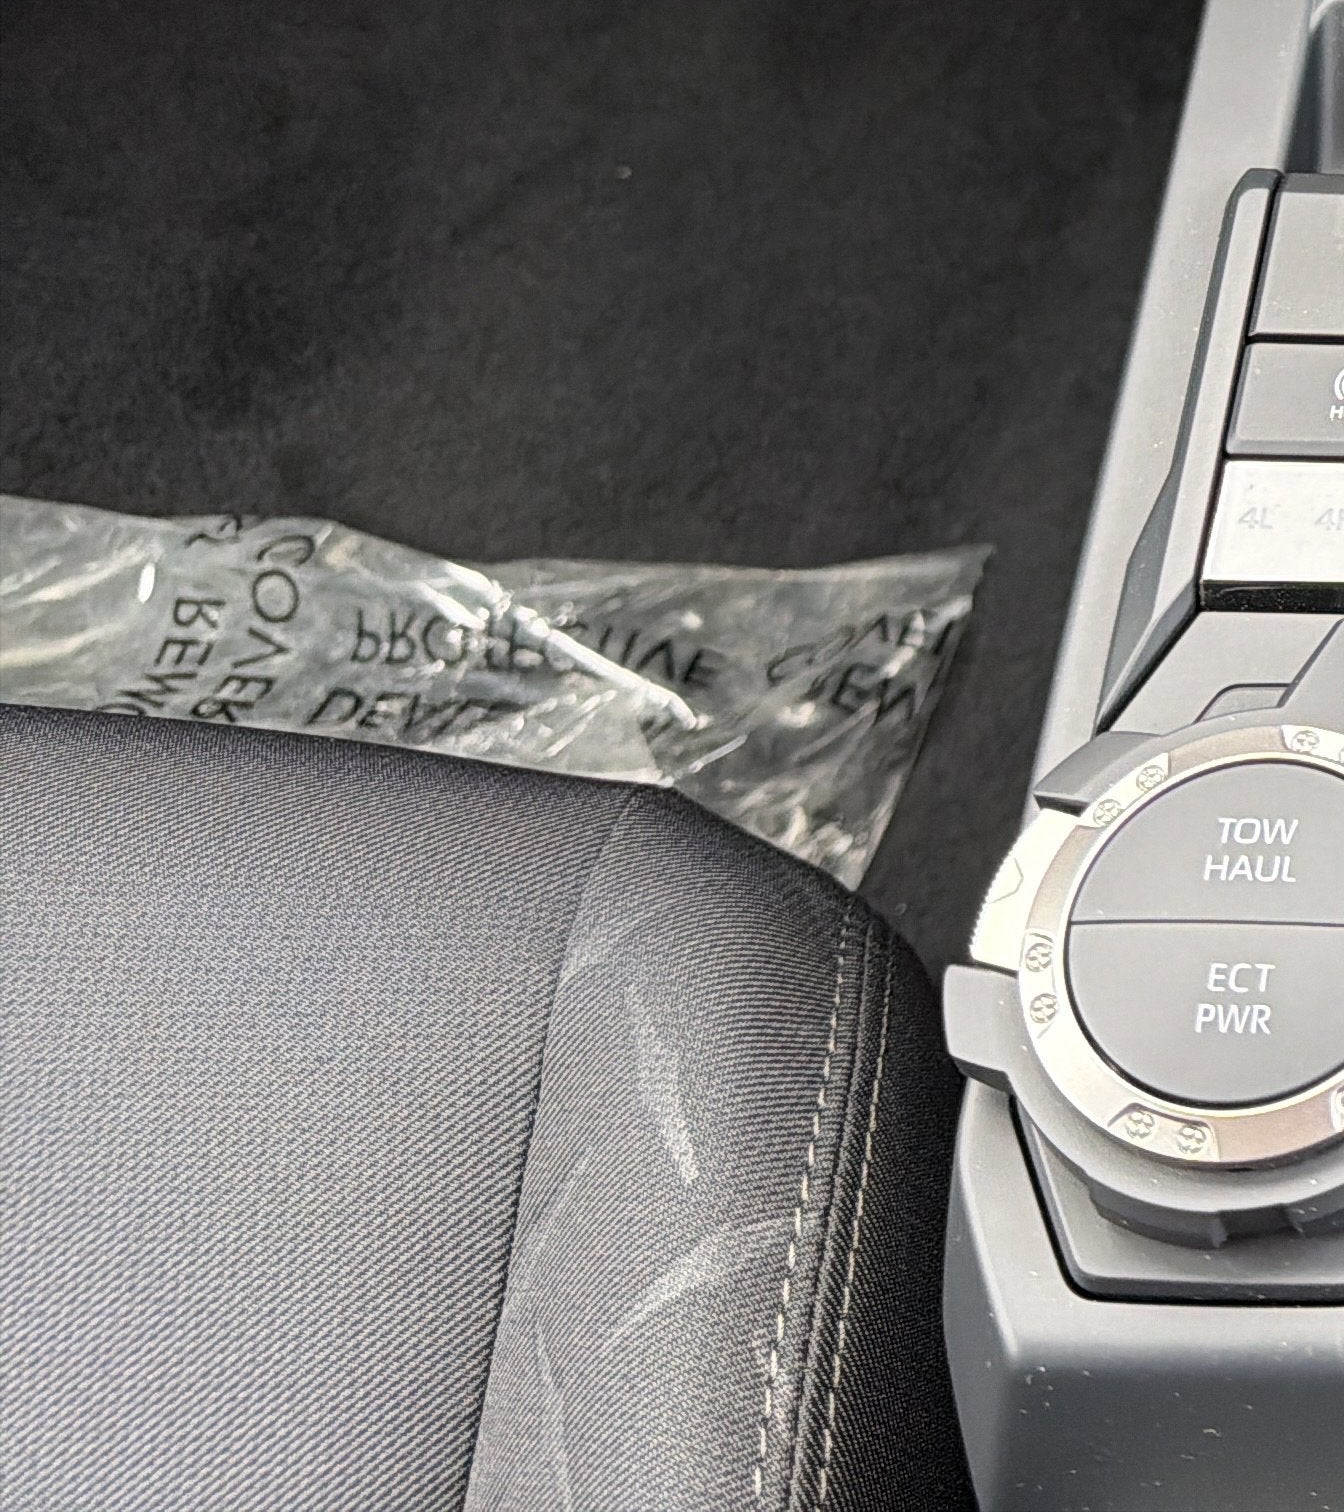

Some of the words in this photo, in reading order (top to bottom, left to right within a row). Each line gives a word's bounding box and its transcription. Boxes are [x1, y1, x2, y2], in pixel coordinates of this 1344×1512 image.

[1237, 506, 1273, 530] 4L
[1218, 817, 1299, 845] TOW
[1203, 854, 1297, 883] HAUL
[1207, 962, 1277, 993] ECT
[1195, 1003, 1271, 1035] PWR
